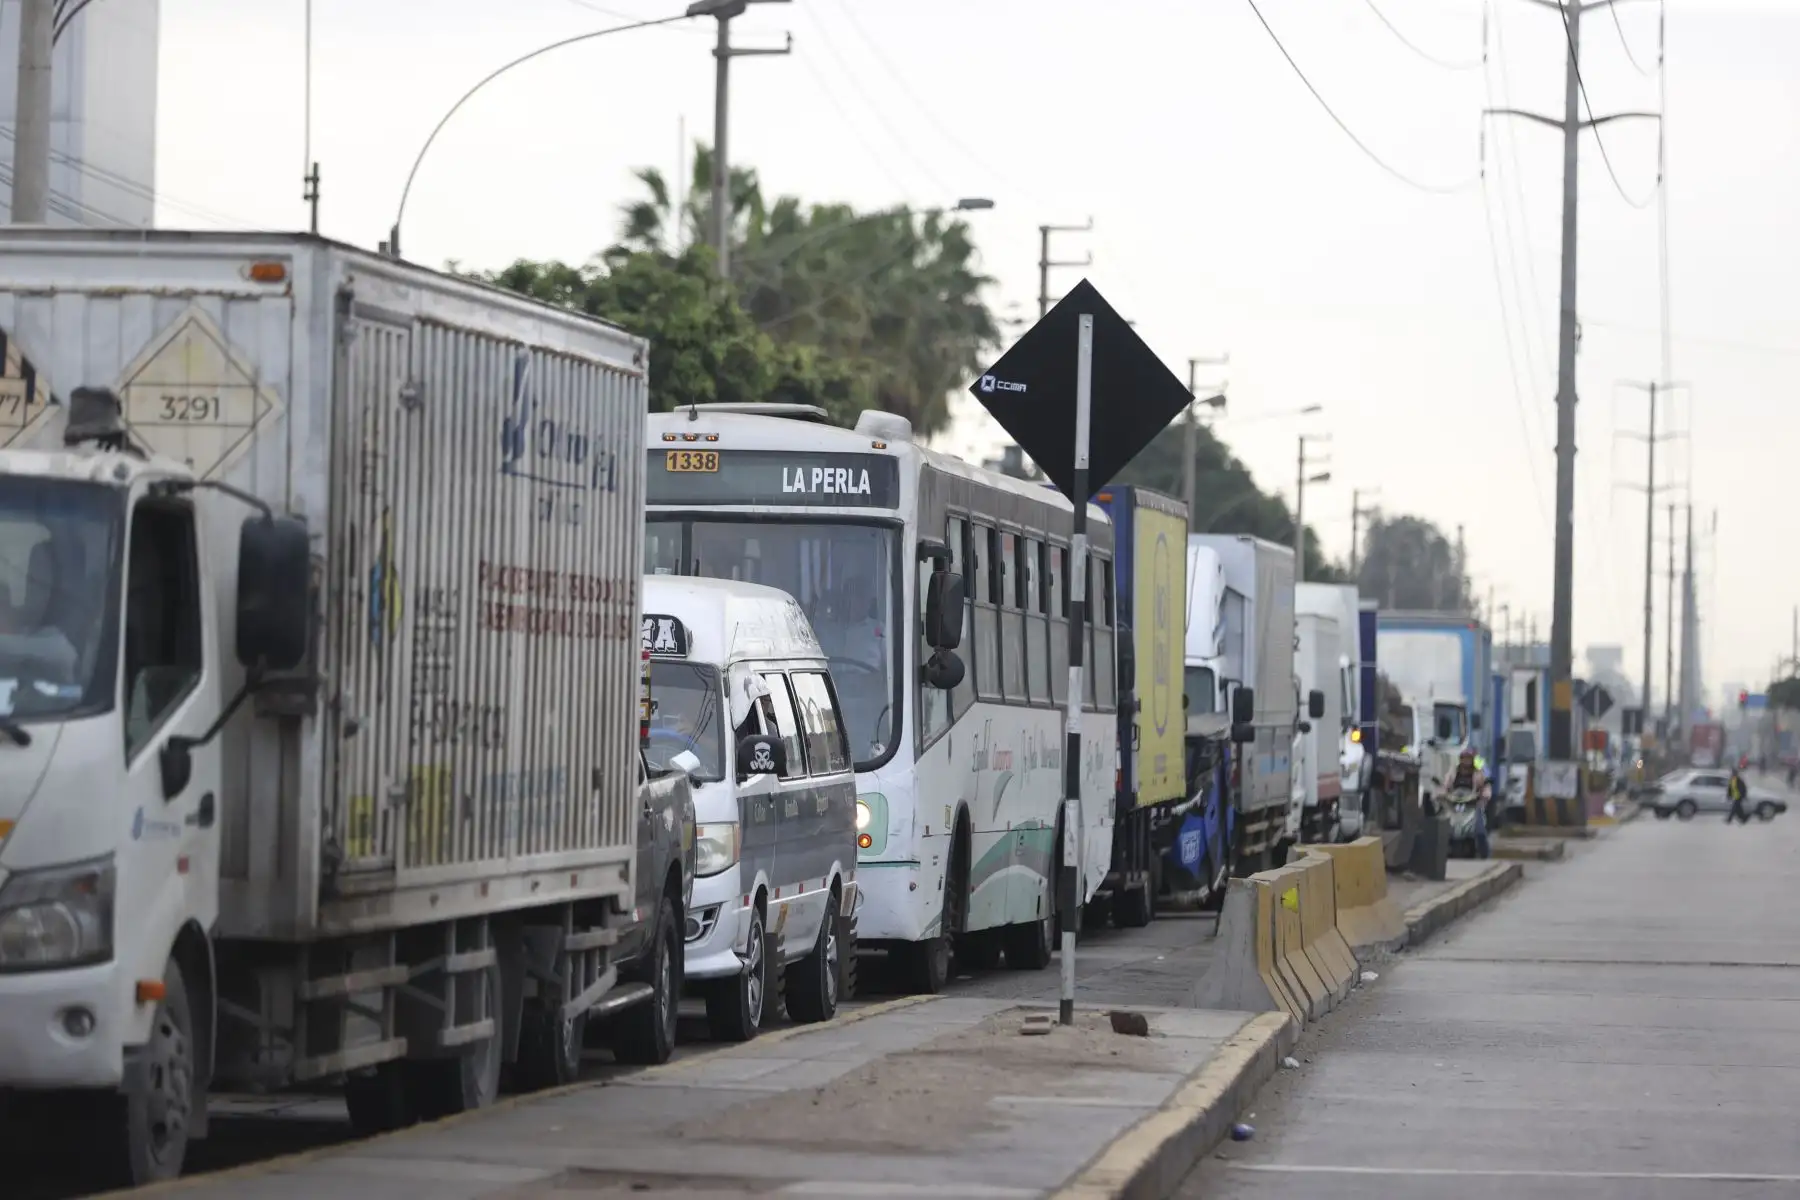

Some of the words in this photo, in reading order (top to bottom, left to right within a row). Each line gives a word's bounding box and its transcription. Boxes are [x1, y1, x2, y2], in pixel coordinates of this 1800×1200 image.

[158, 395, 220, 421] 3291
[668, 452, 717, 471] 1338
[782, 467, 806, 493] LA
[811, 467, 872, 495] PERLA
